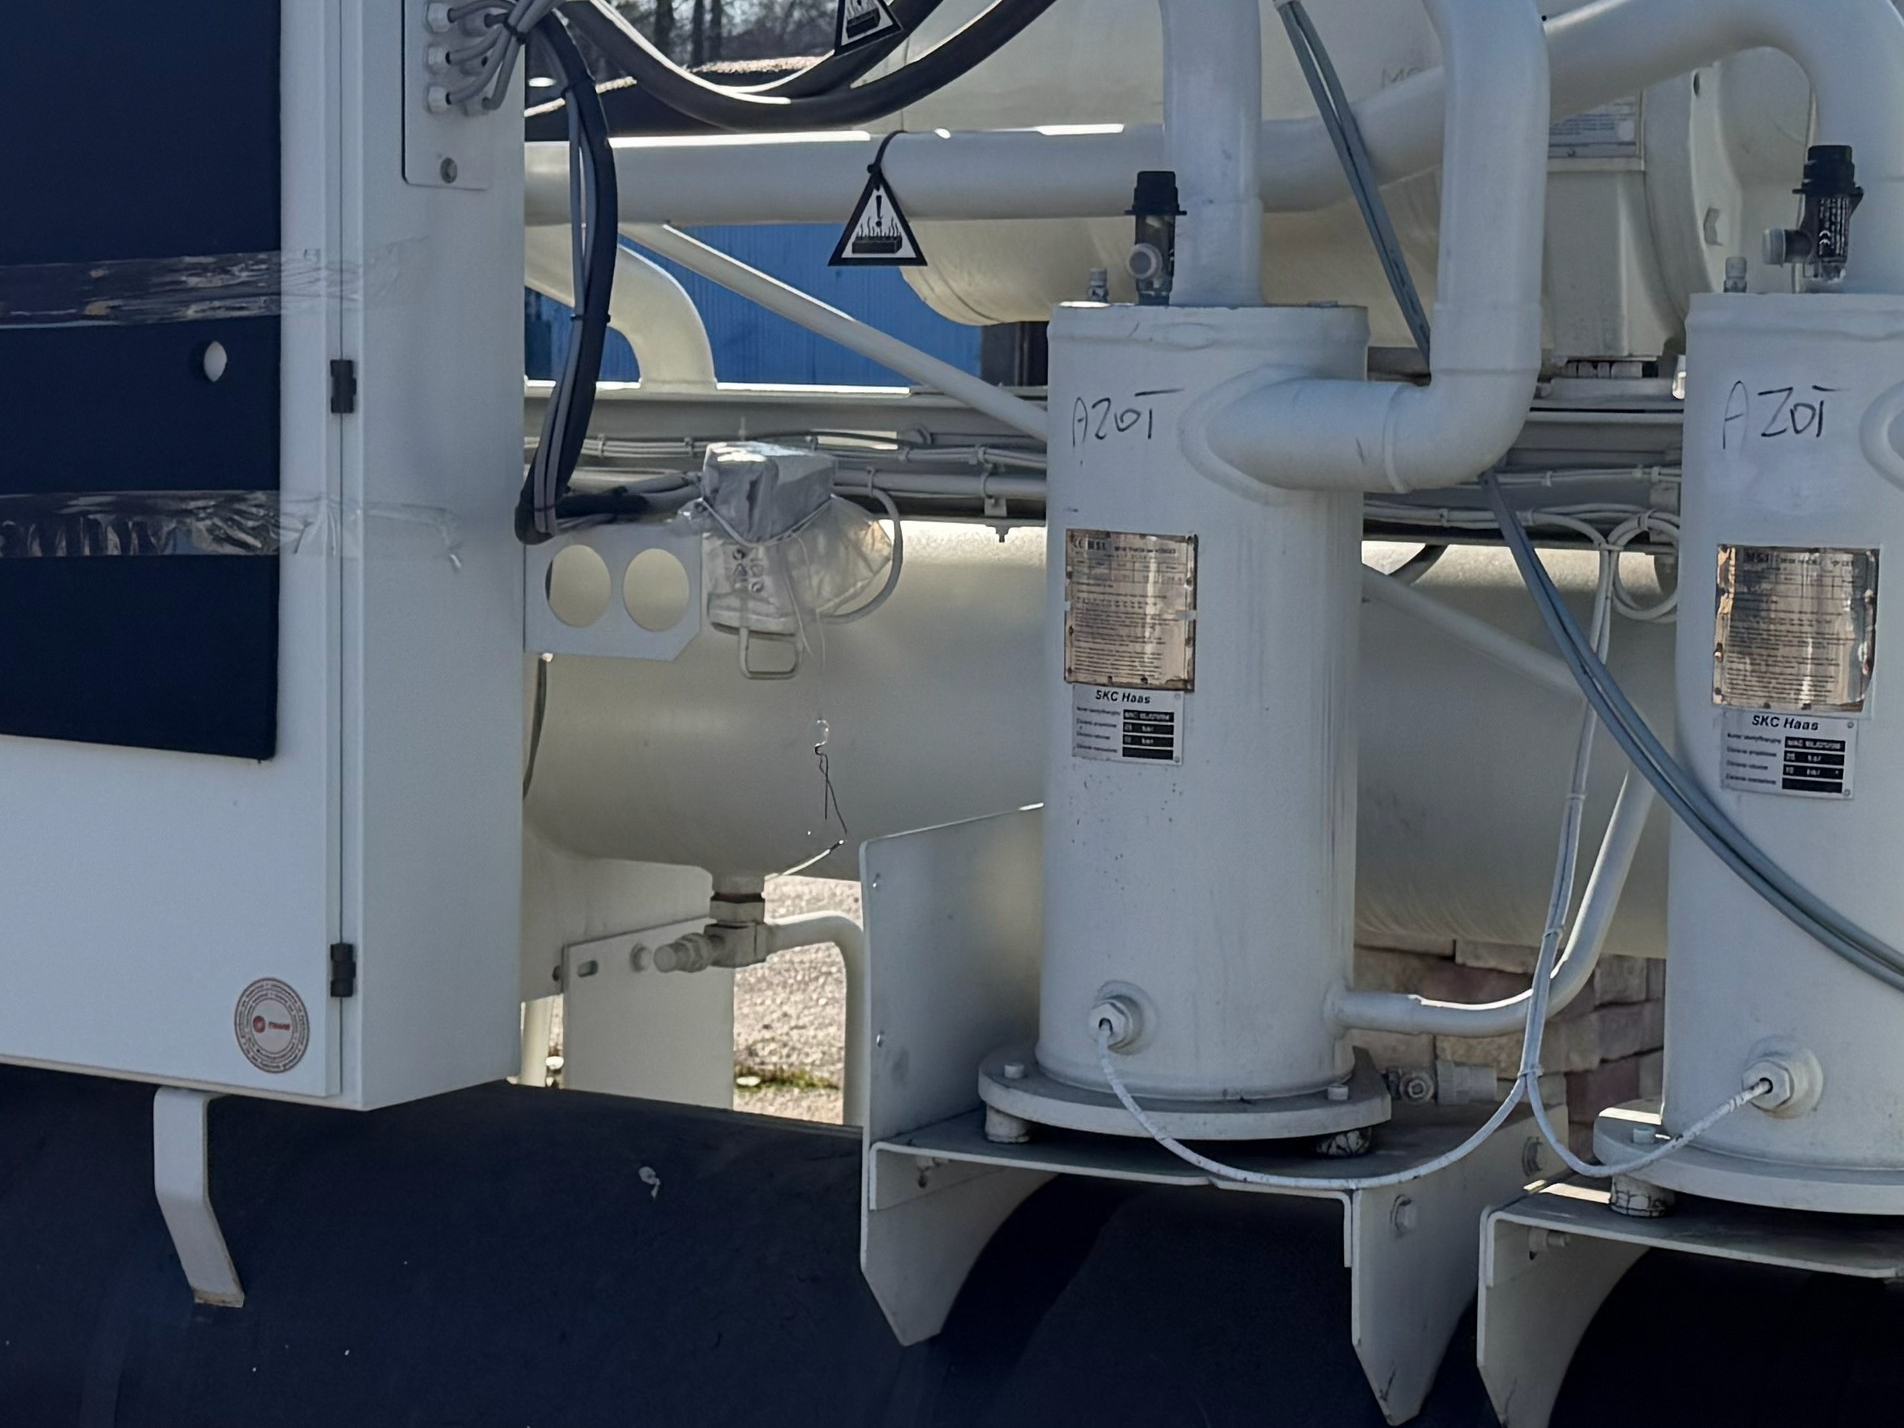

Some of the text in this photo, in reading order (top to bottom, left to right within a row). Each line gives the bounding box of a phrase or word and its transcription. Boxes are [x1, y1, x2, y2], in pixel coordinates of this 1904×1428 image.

[1722, 380, 1851, 454] AZOT
[1095, 690, 1151, 704] SKC Haas
[1752, 714, 1819, 731] SKC Haas
